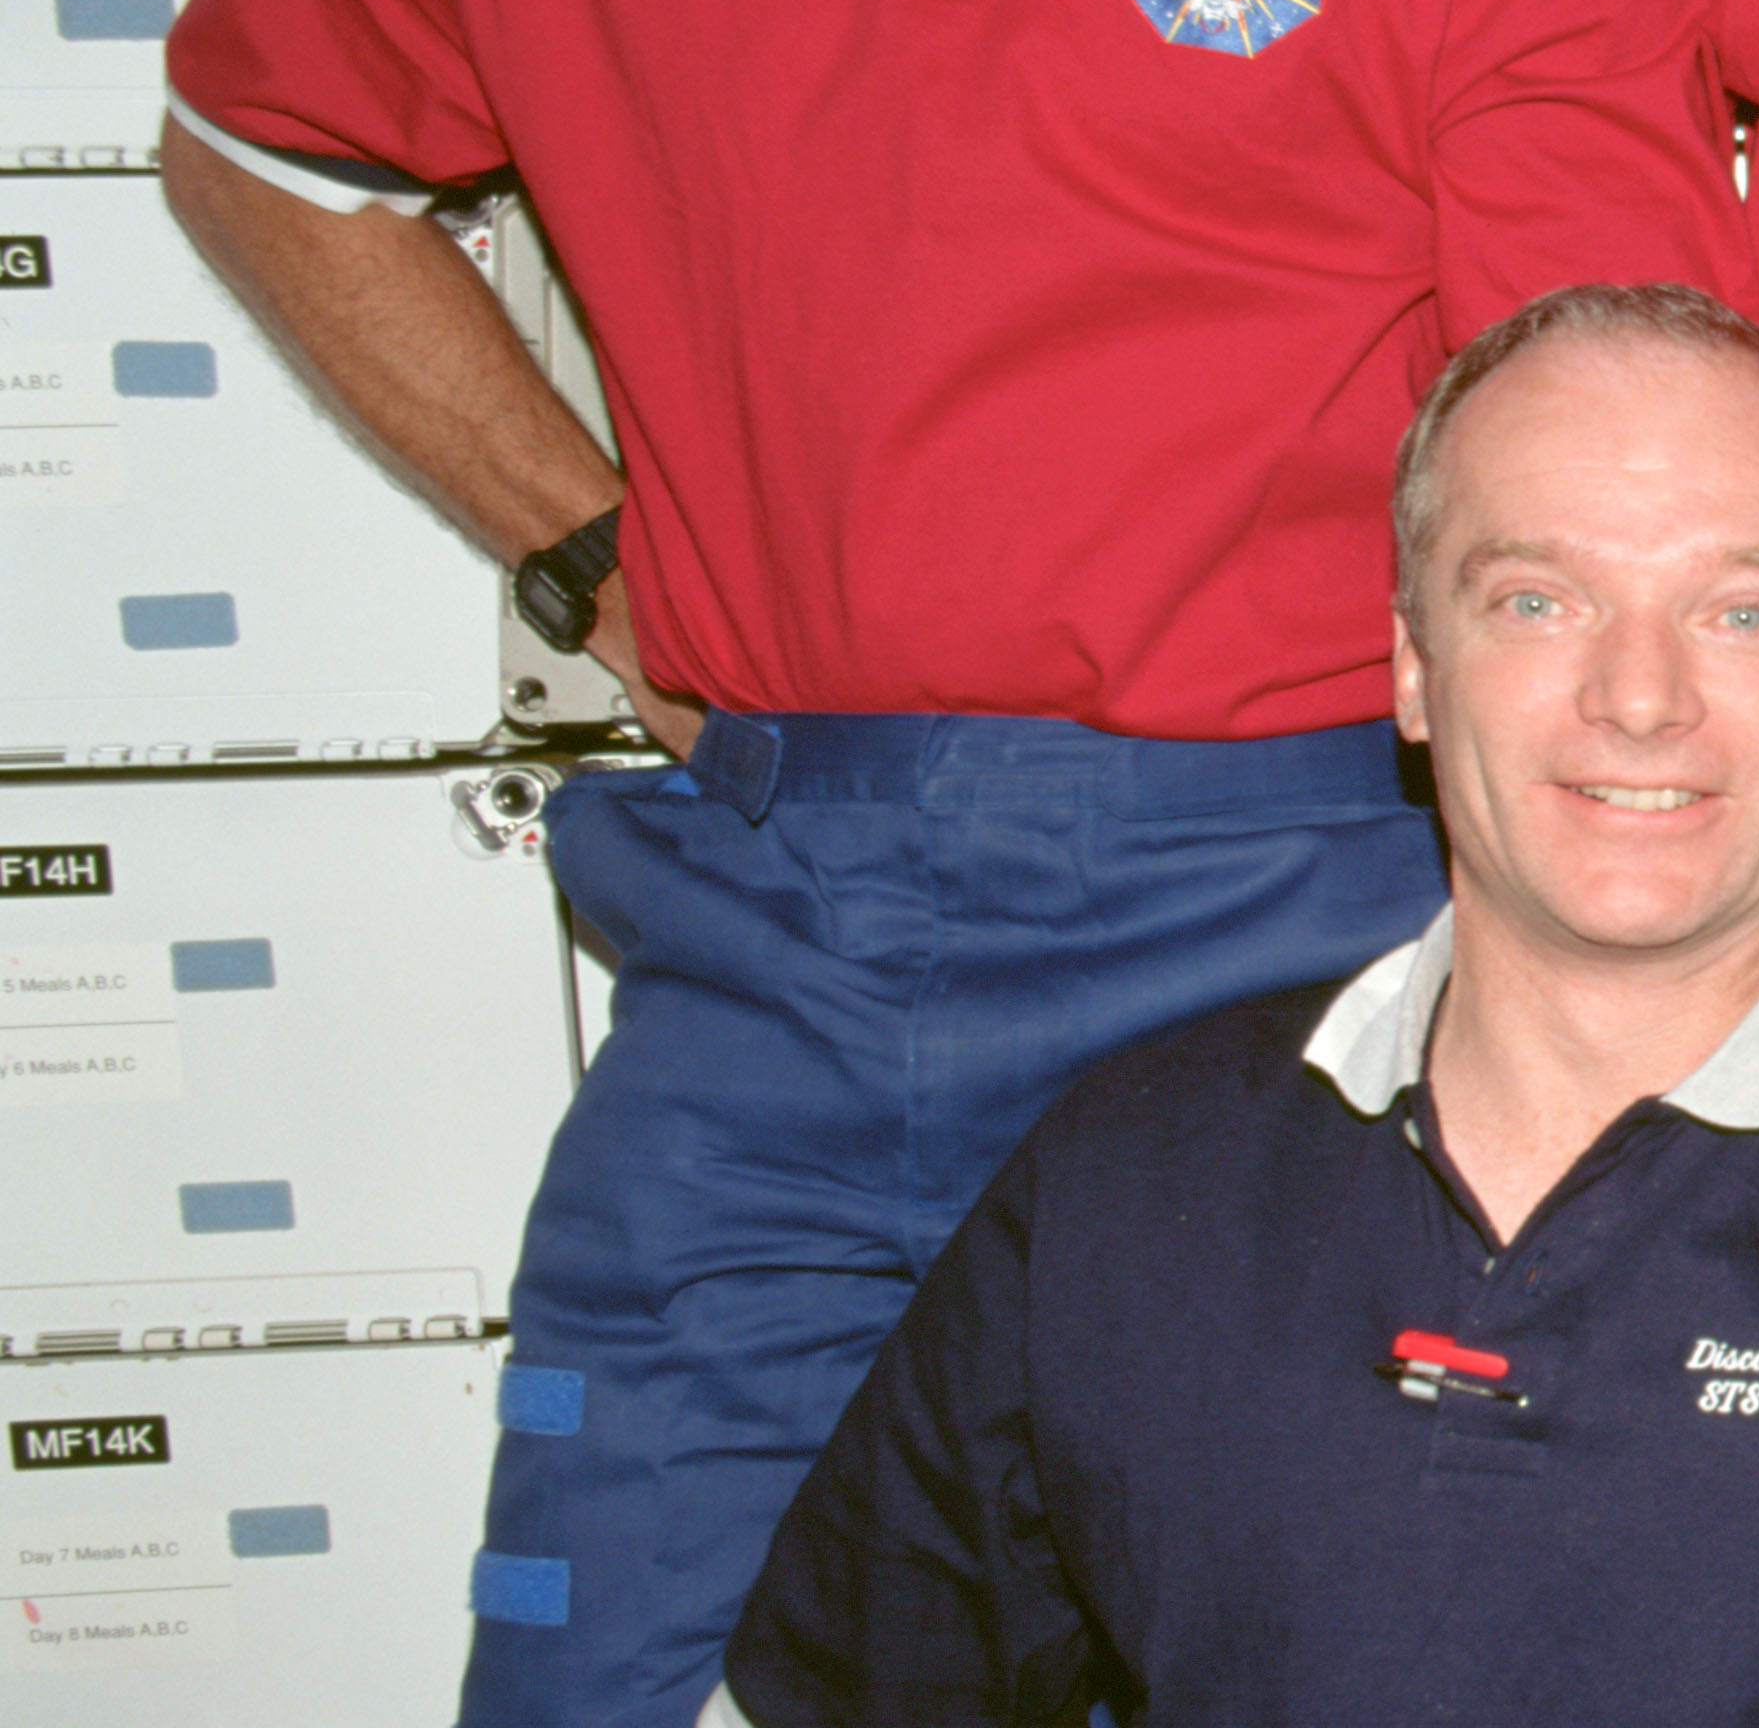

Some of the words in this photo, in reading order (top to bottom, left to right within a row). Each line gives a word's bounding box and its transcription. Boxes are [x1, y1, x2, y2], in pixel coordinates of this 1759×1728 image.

[19, 977, 72, 992] Meals
[13, 1061, 25, 1076] 6
[29, 1059, 81, 1075] Meals
[25, 1423, 156, 1460] MF14K
[19, 1548, 54, 1567] Day
[58, 1548, 70, 1561] 7
[74, 1546, 127, 1561] Meals
[29, 1627, 64, 1646] Day
[68, 1626, 80, 1641] 8
[84, 1624, 136, 1640] Meals
